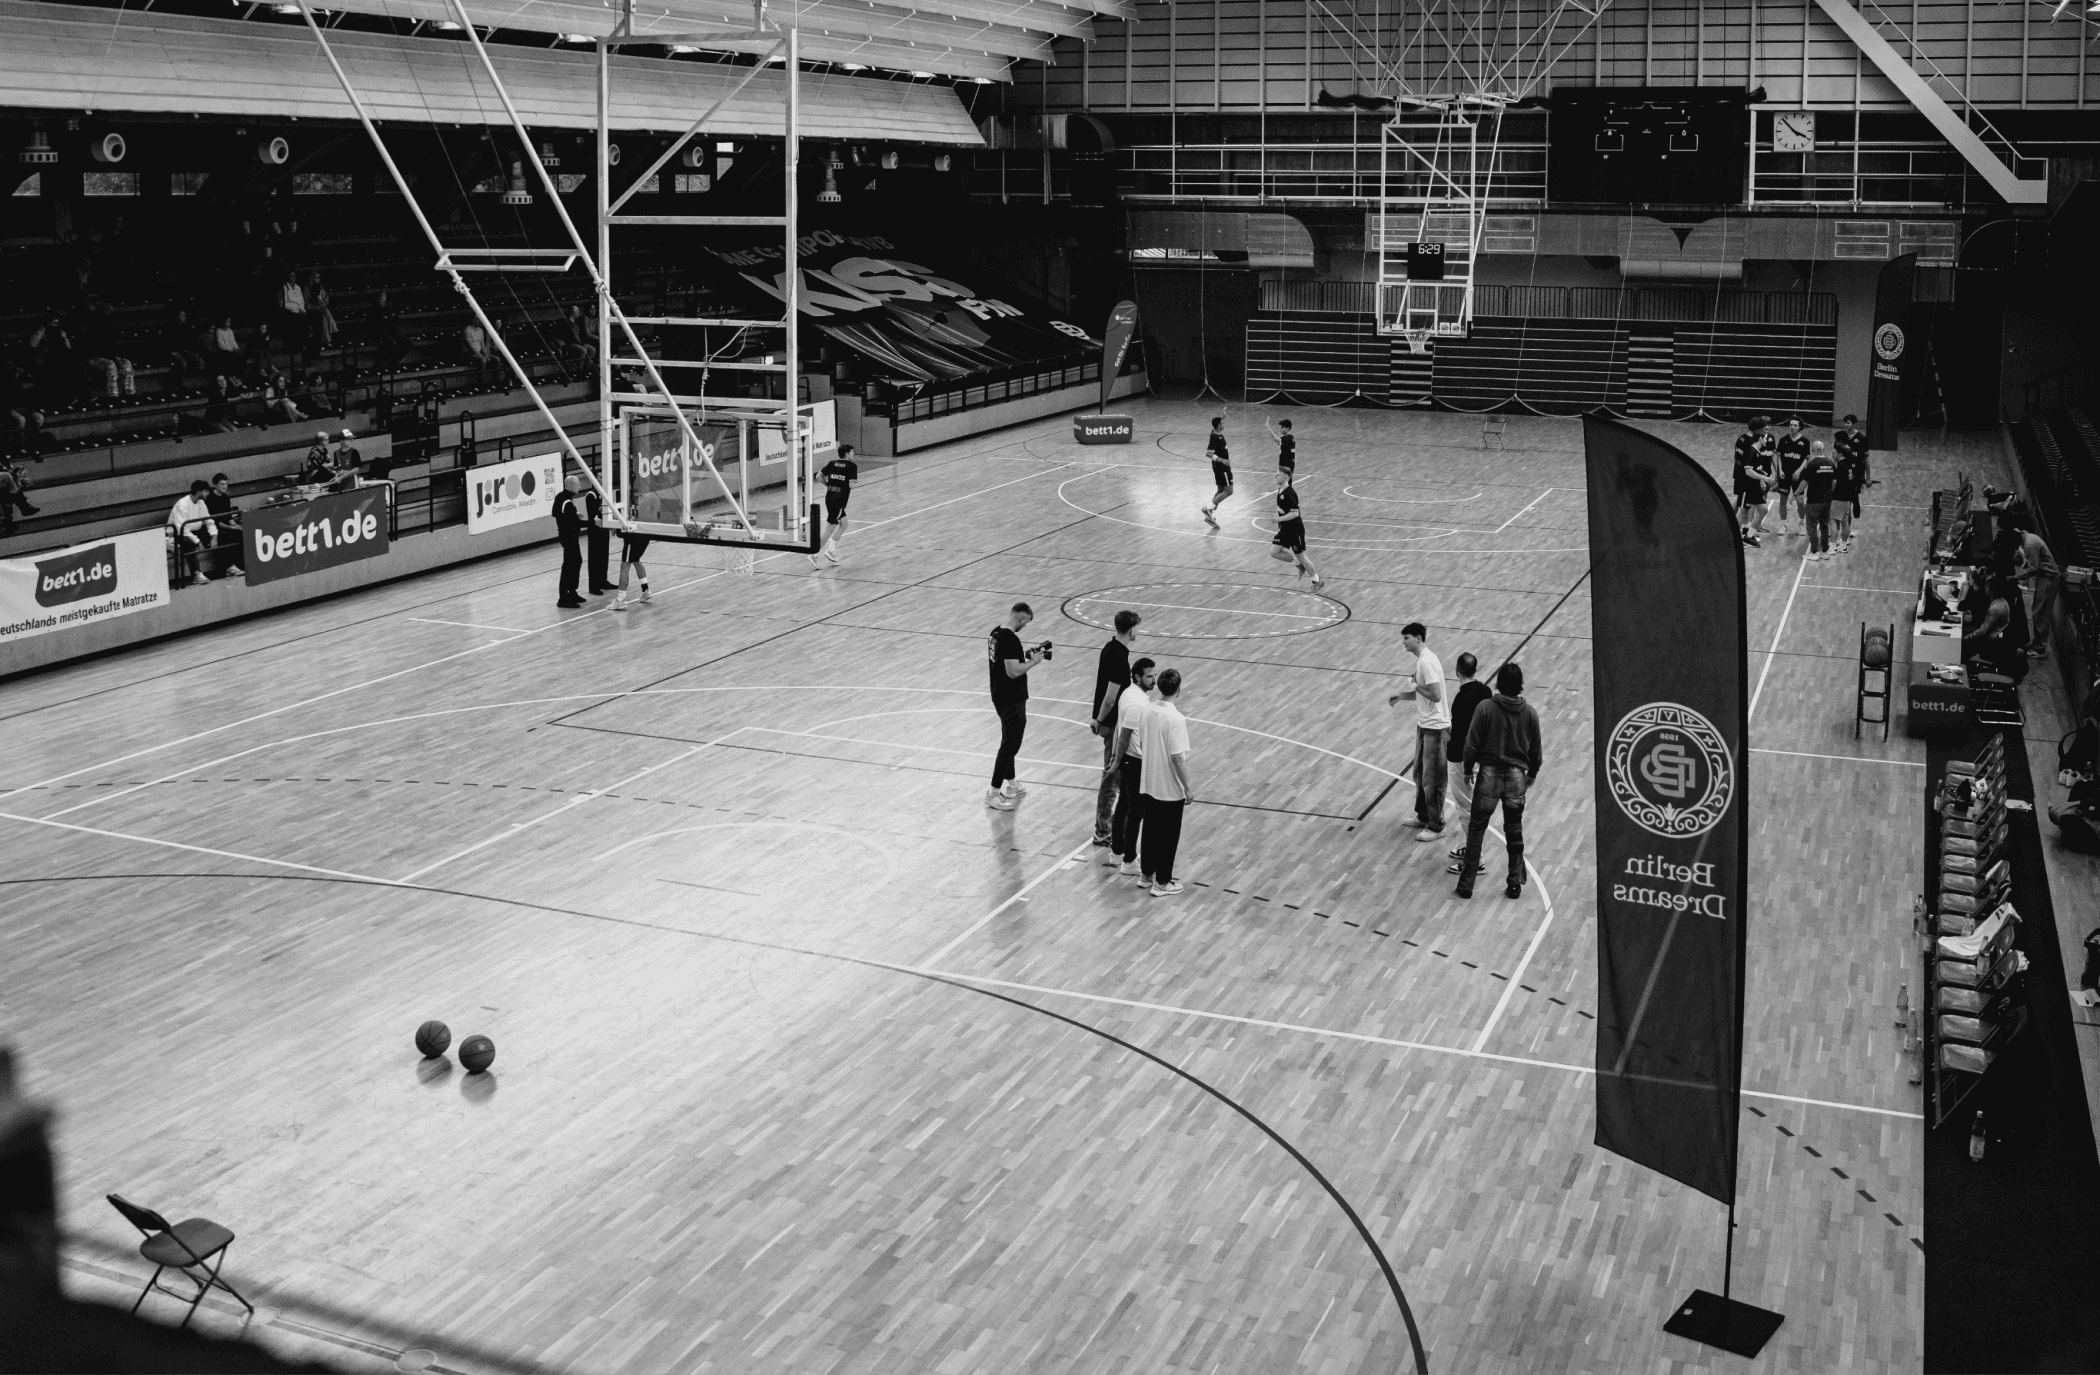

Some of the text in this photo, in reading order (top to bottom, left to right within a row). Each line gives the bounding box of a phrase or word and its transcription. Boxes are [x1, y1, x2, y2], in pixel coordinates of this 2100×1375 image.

[1418, 243, 1441, 255] 6:29
[1877, 362, 1898, 373] Berlin
[1874, 370, 1900, 381] Dreams
[1085, 425, 1130, 436] bett1.de
[254, 510, 378, 562] bett1.de
[42, 562, 113, 592] bett1.de
[0, 592, 158, 636] eutschlands meistgekaufte Matratze
[1912, 699, 1966, 713] bett1.de
